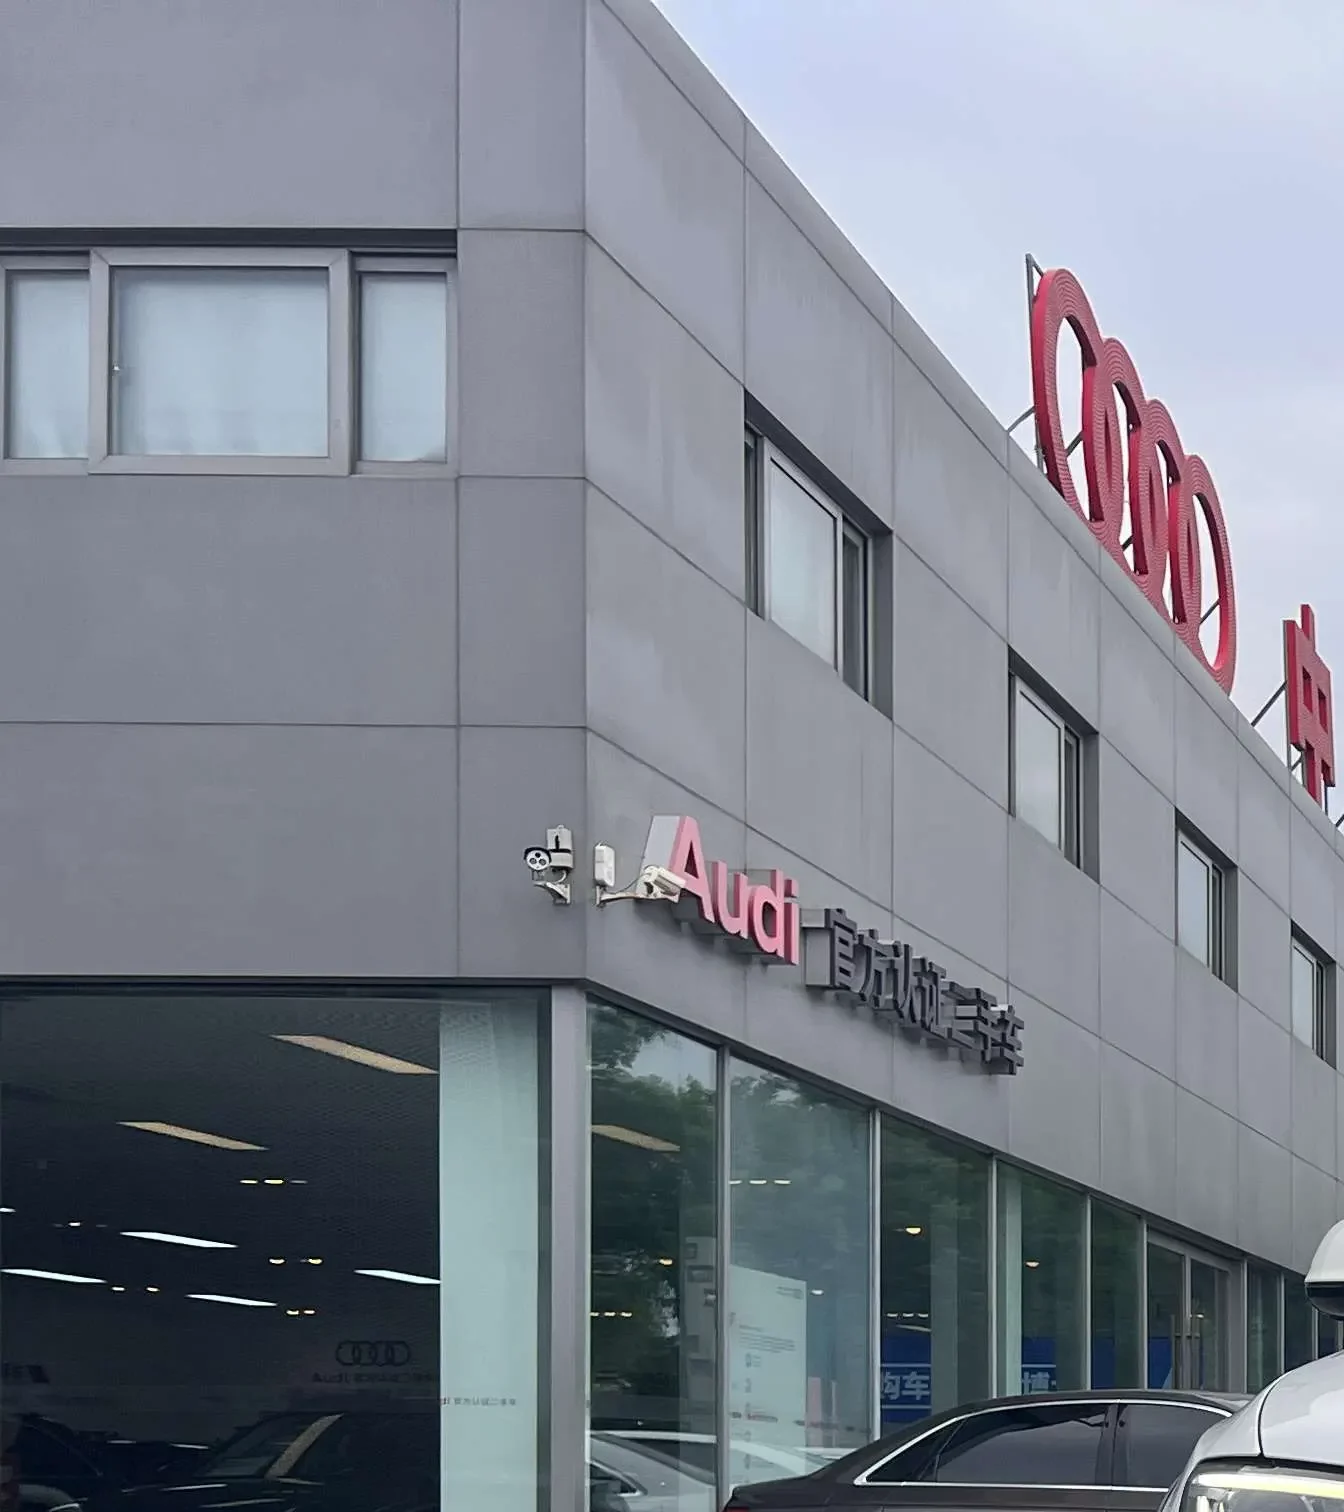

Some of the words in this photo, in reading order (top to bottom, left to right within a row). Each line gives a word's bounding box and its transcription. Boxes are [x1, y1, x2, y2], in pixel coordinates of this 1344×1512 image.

[660, 815, 801, 966] Audi
[818, 906, 1026, 1076] 官方认证二手车
